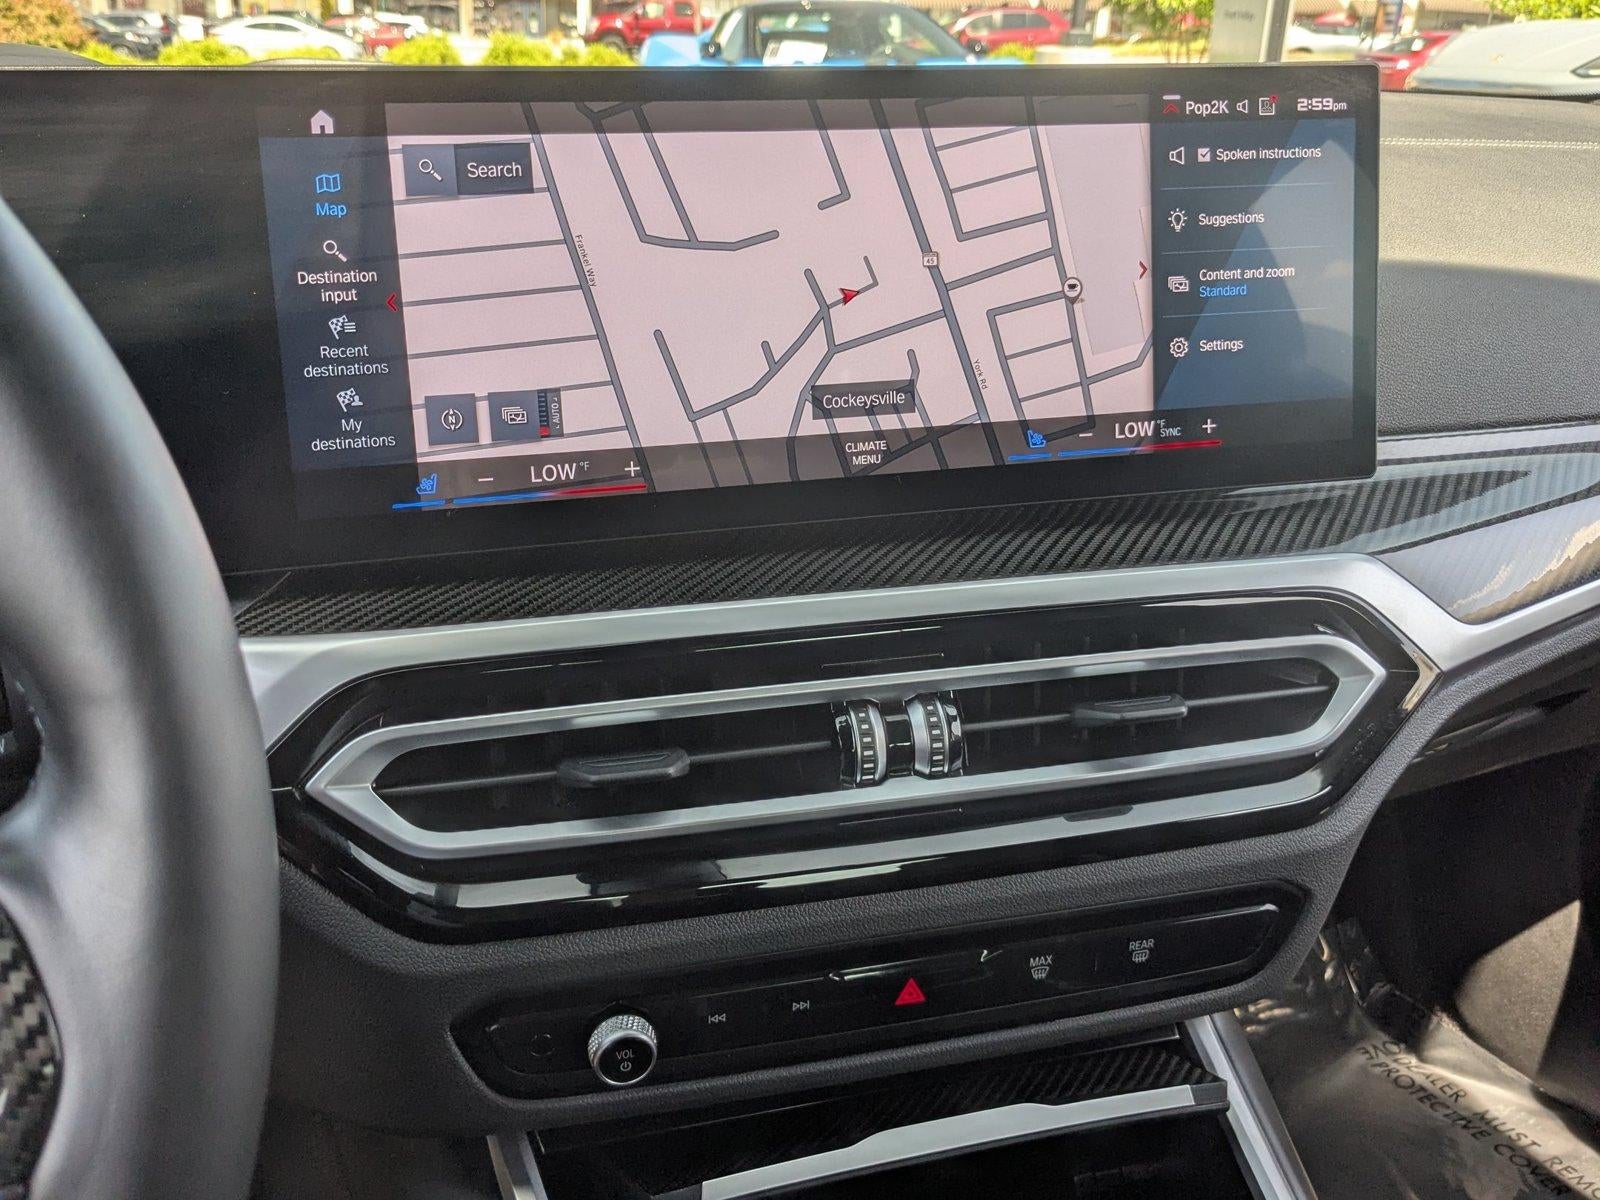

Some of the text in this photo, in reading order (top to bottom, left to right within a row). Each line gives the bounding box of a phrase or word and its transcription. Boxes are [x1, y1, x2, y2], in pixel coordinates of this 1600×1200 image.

[1185, 100, 1230, 117] Pop2K
[1216, 146, 1322, 162] Spoken instructions
[467, 161, 523, 179] Search
[316, 203, 347, 218] Map
[1198, 211, 1265, 227] Suggestions
[575, 234, 598, 288] Frankel Way
[297, 270, 378, 285] Destination
[1199, 266, 1296, 281] Content and zoom
[321, 289, 358, 304] input
[1199, 284, 1247, 298] Standard
[320, 344, 369, 359] Recent
[1199, 338, 1244, 352] Settings
[304, 362, 389, 377] destinations
[974, 358, 989, 390] York Rd
[823, 390, 906, 409] Cockeysville
[341, 418, 362, 433] My
[1115, 420, 1156, 439] LOW
[1160, 427, 1182, 438] SYNC
[311, 435, 396, 451] destinations
[845, 440, 888, 453] CLIMATE
[852, 454, 882, 466] MENU
[530, 463, 577, 483] LOW
[1129, 938, 1155, 951] REAR
[1029, 955, 1053, 968] MAX
[615, 1049, 635, 1060] VOL
[1472, 1109, 1542, 1148] MUST
